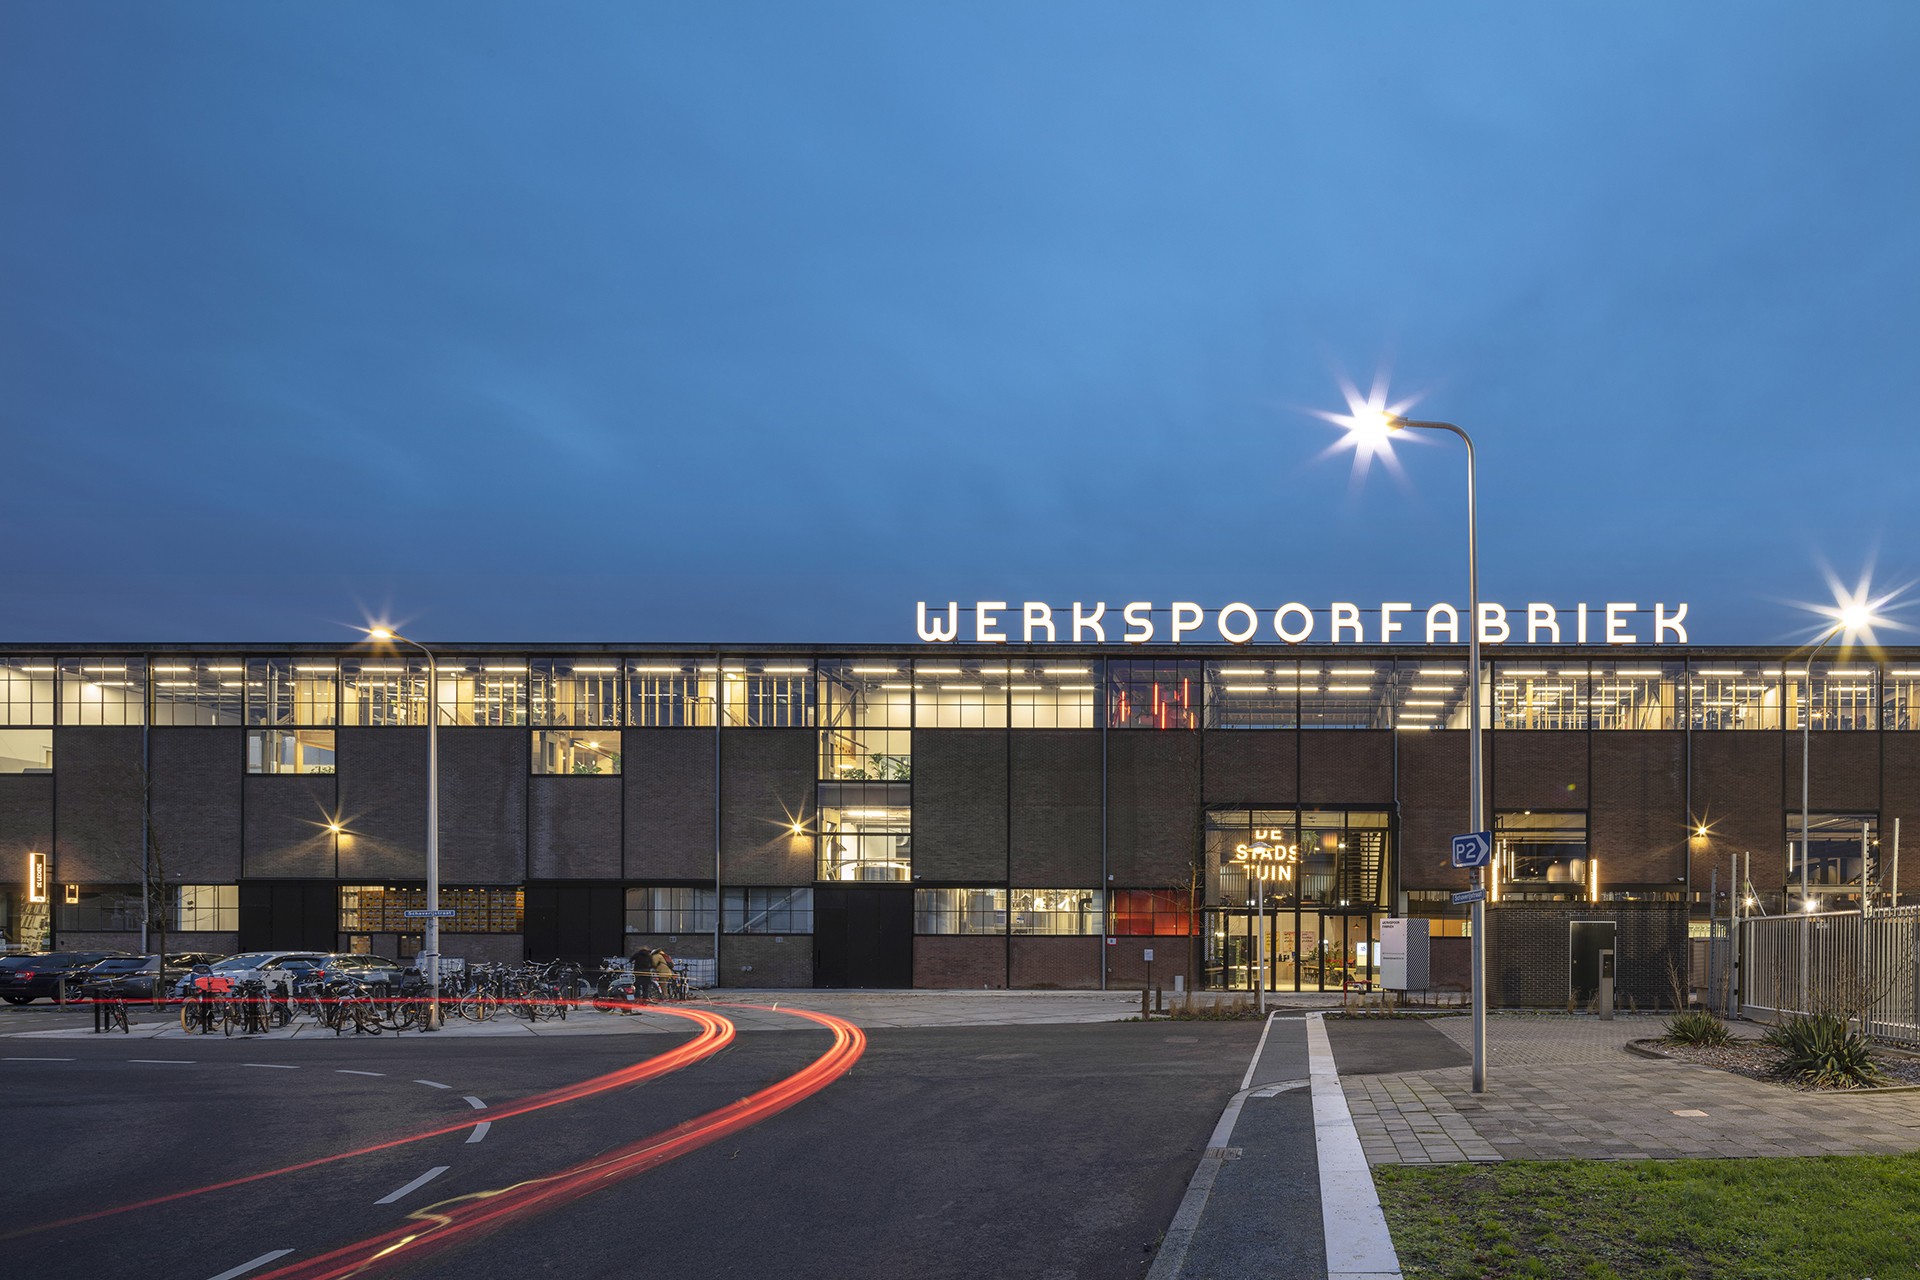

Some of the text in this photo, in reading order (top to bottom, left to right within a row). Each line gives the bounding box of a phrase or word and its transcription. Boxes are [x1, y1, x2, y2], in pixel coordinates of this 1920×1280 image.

[916, 601, 1688, 643] WERKSPOORFABRIEK
[1456, 842, 1476, 860] P2
[1243, 865, 1291, 881] TUIN
